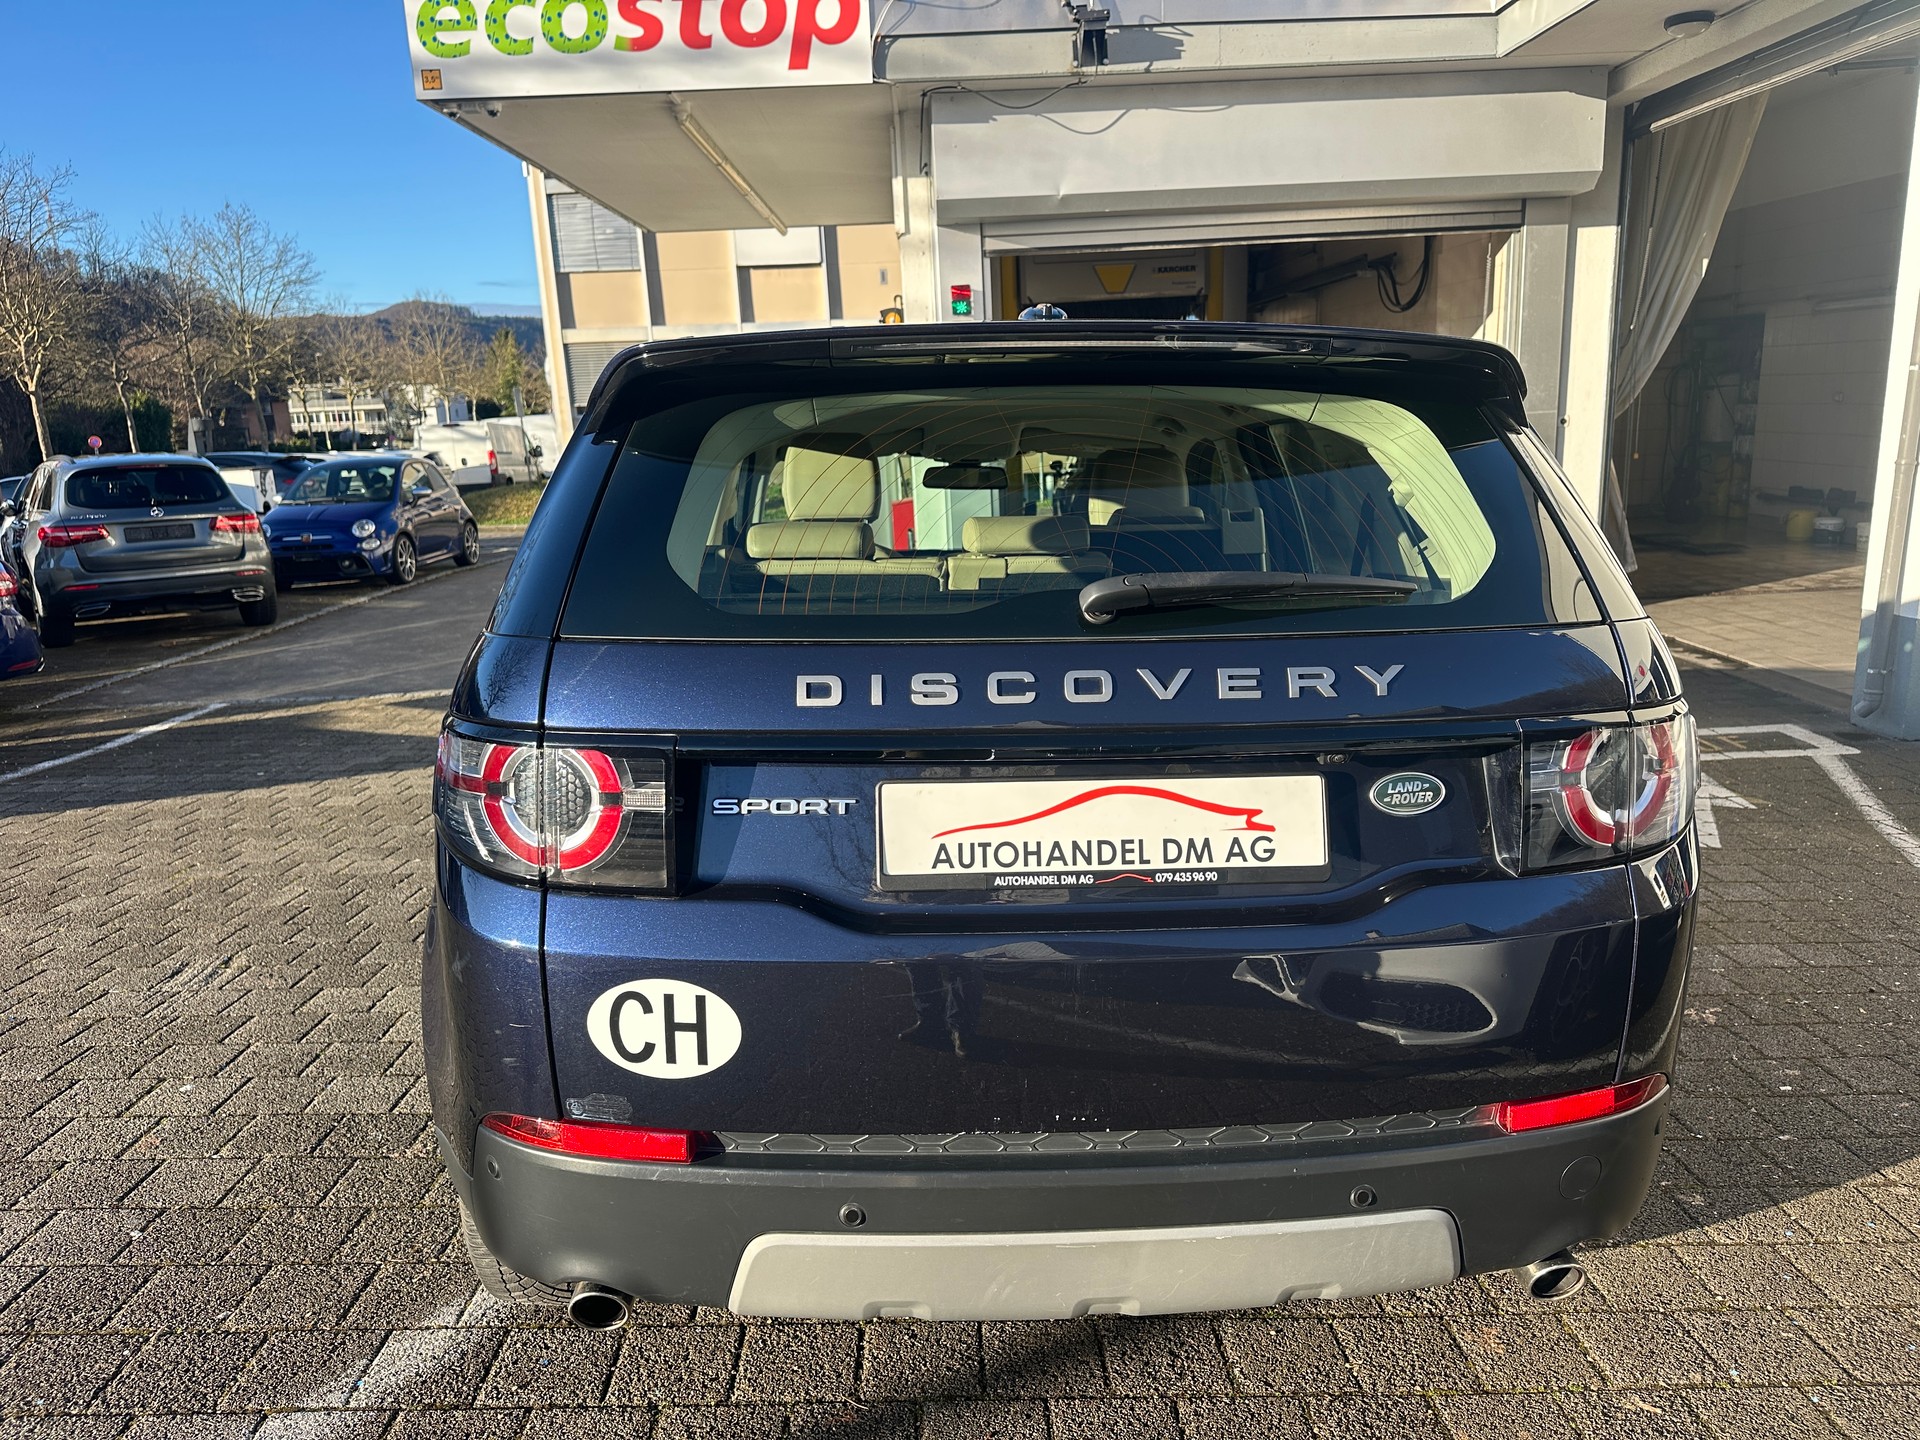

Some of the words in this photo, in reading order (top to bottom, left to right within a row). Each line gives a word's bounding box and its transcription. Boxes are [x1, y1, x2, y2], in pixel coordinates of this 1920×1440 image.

[416, 0, 860, 71] ecostop
[796, 664, 1404, 707] DISCOVERY
[1387, 781, 1422, 794] LAND
[1391, 791, 1433, 805] ROVER
[712, 799, 858, 815] SPORT
[931, 838, 1151, 869] AUTOHANDEL
[1163, 837, 1212, 865] DM
[1225, 835, 1276, 863] AG
[994, 875, 1059, 886] AUTOHANDEL
[1061, 875, 1076, 885] DM
[1078, 874, 1094, 885] AG
[609, 991, 708, 1066] CH
